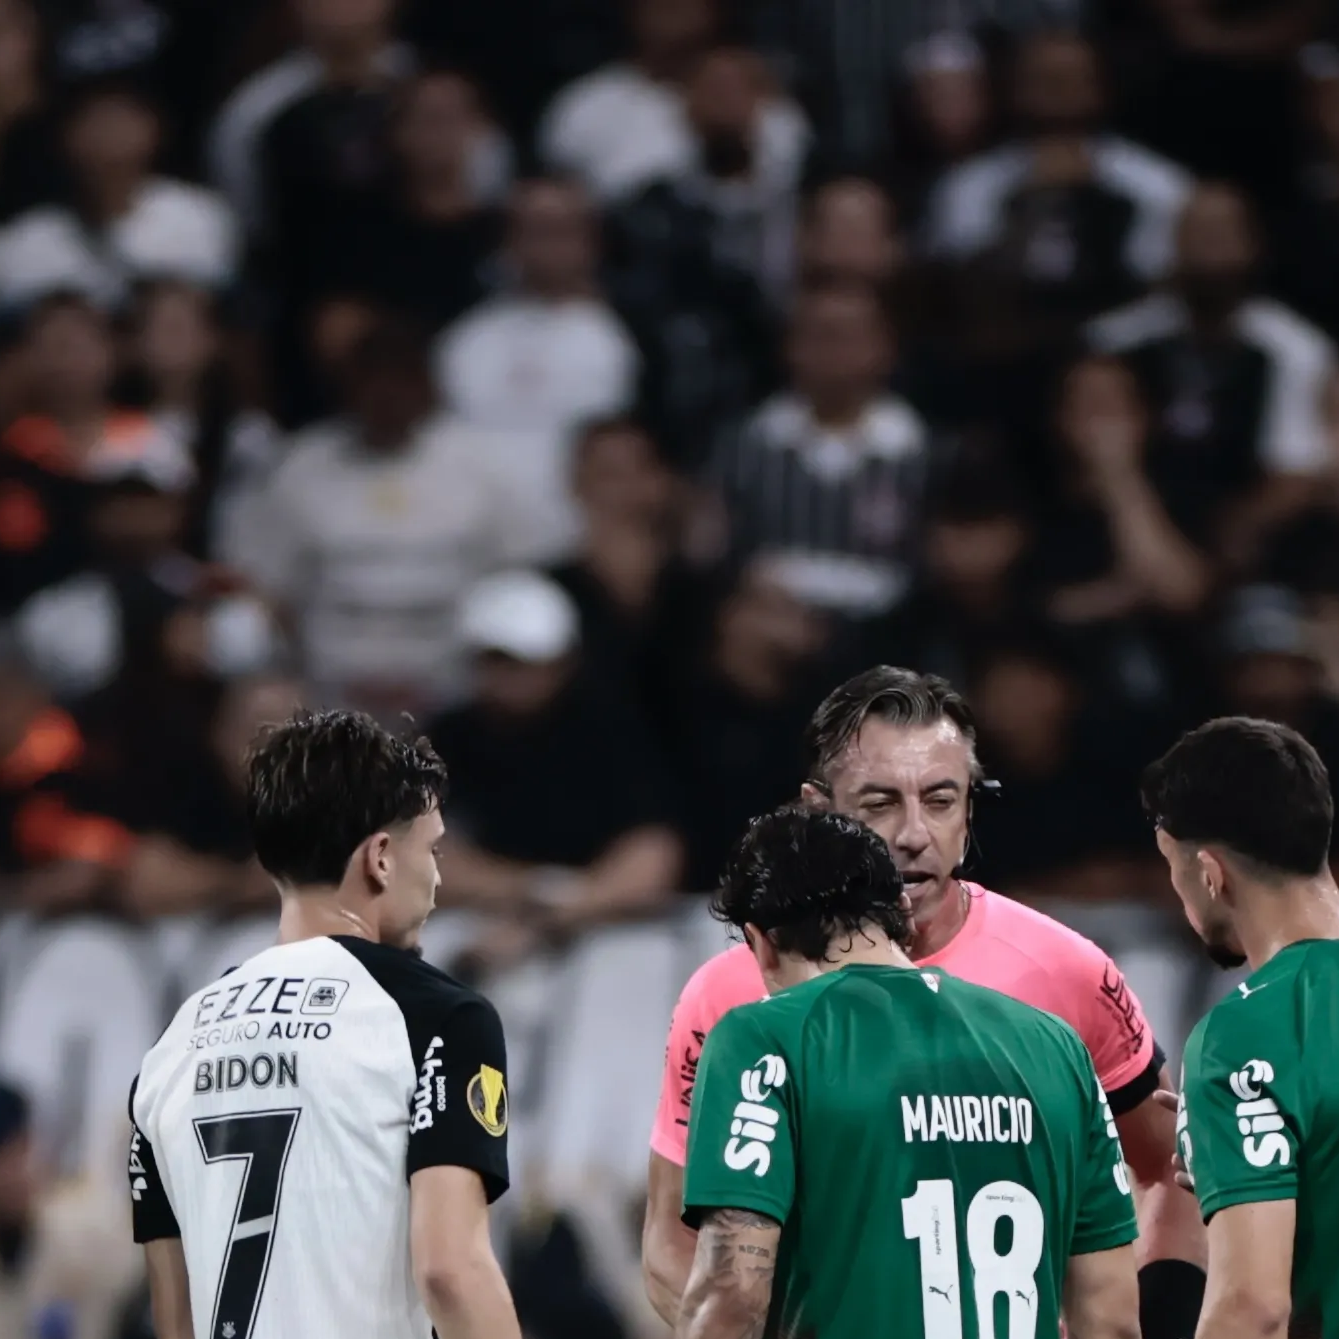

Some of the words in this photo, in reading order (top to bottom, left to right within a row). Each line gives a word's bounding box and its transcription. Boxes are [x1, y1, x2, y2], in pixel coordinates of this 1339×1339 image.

[193, 977, 305, 1029] EZZE
[186, 1021, 260, 1051] SEGURO
[267, 1021, 332, 1040] AUTO
[193, 1052, 300, 1095] BIDON
[900, 1095, 1033, 1145] MAURICIO
